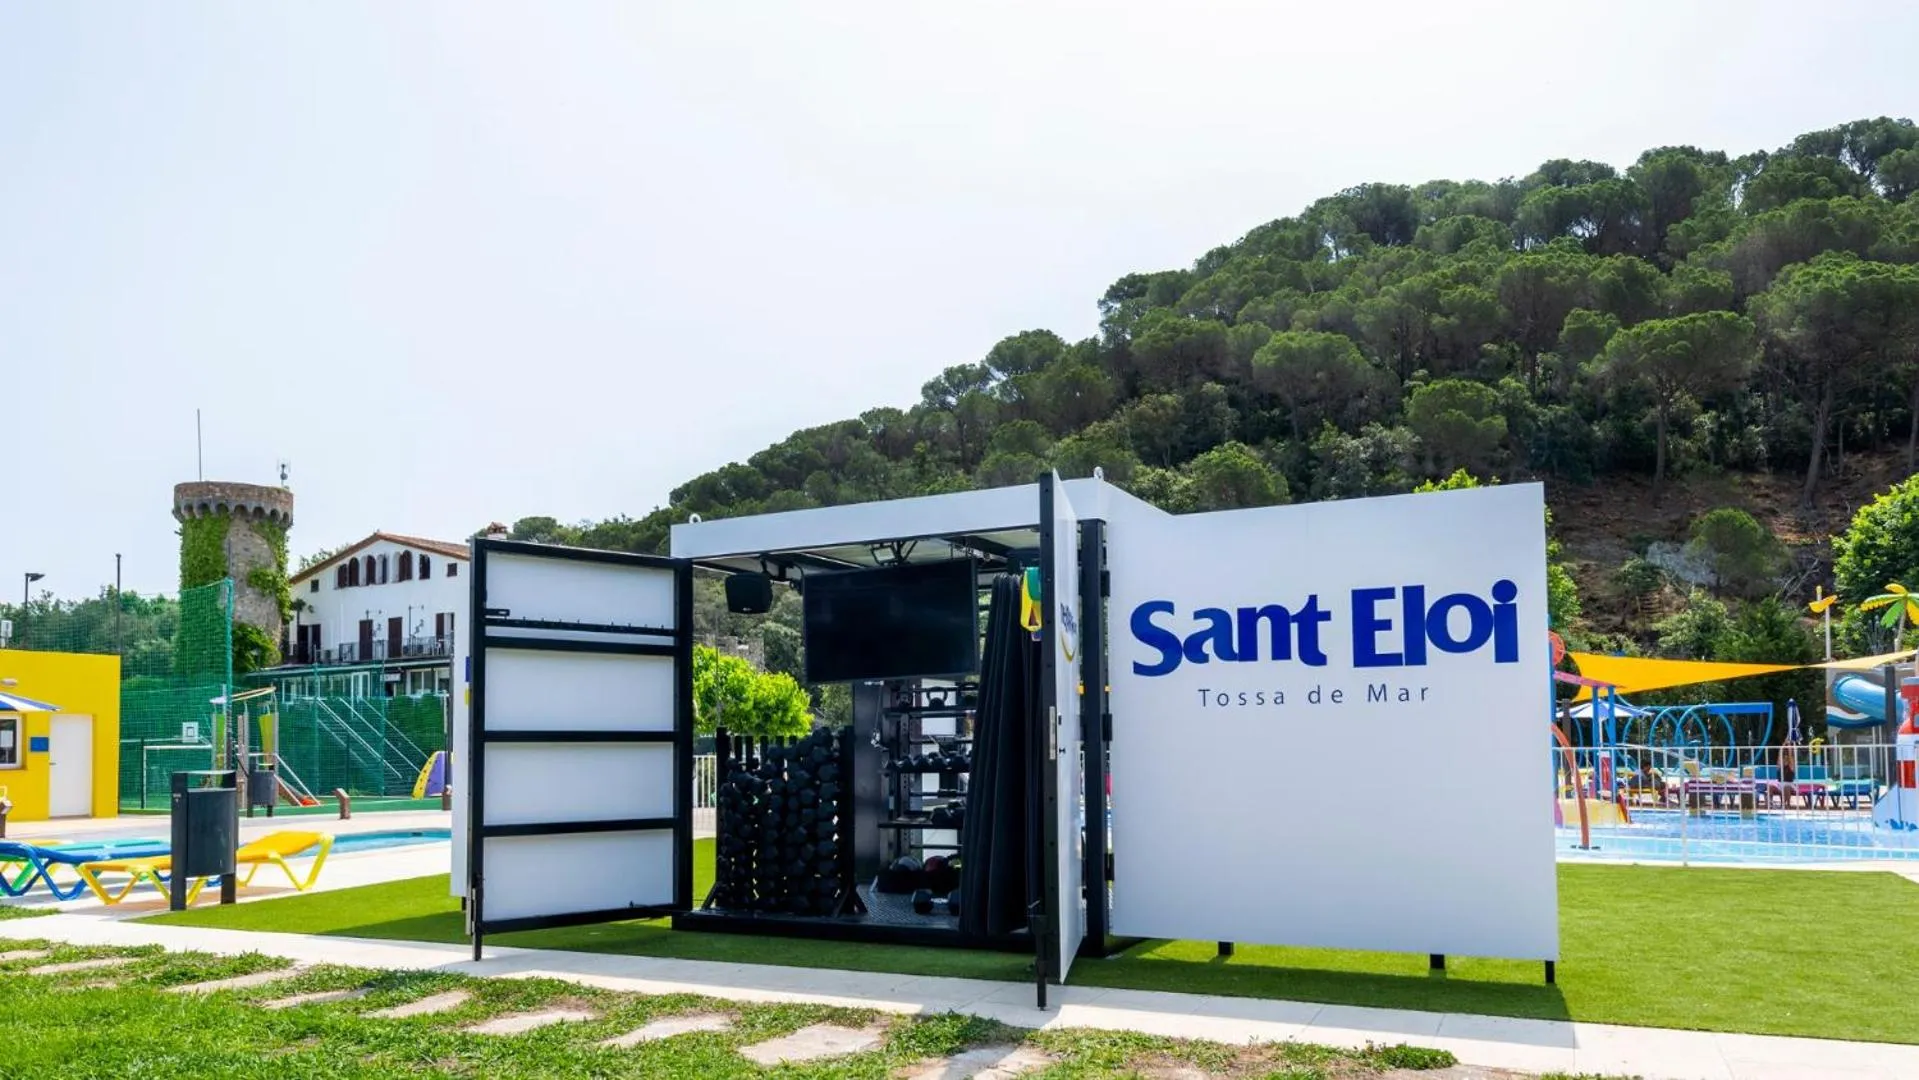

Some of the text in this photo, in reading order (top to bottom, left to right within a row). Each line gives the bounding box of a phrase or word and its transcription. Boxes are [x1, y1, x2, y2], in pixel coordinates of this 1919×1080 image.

[1130, 579, 1519, 677] Sant Eloi
[1197, 683, 1429, 708] Tossa de Mar
